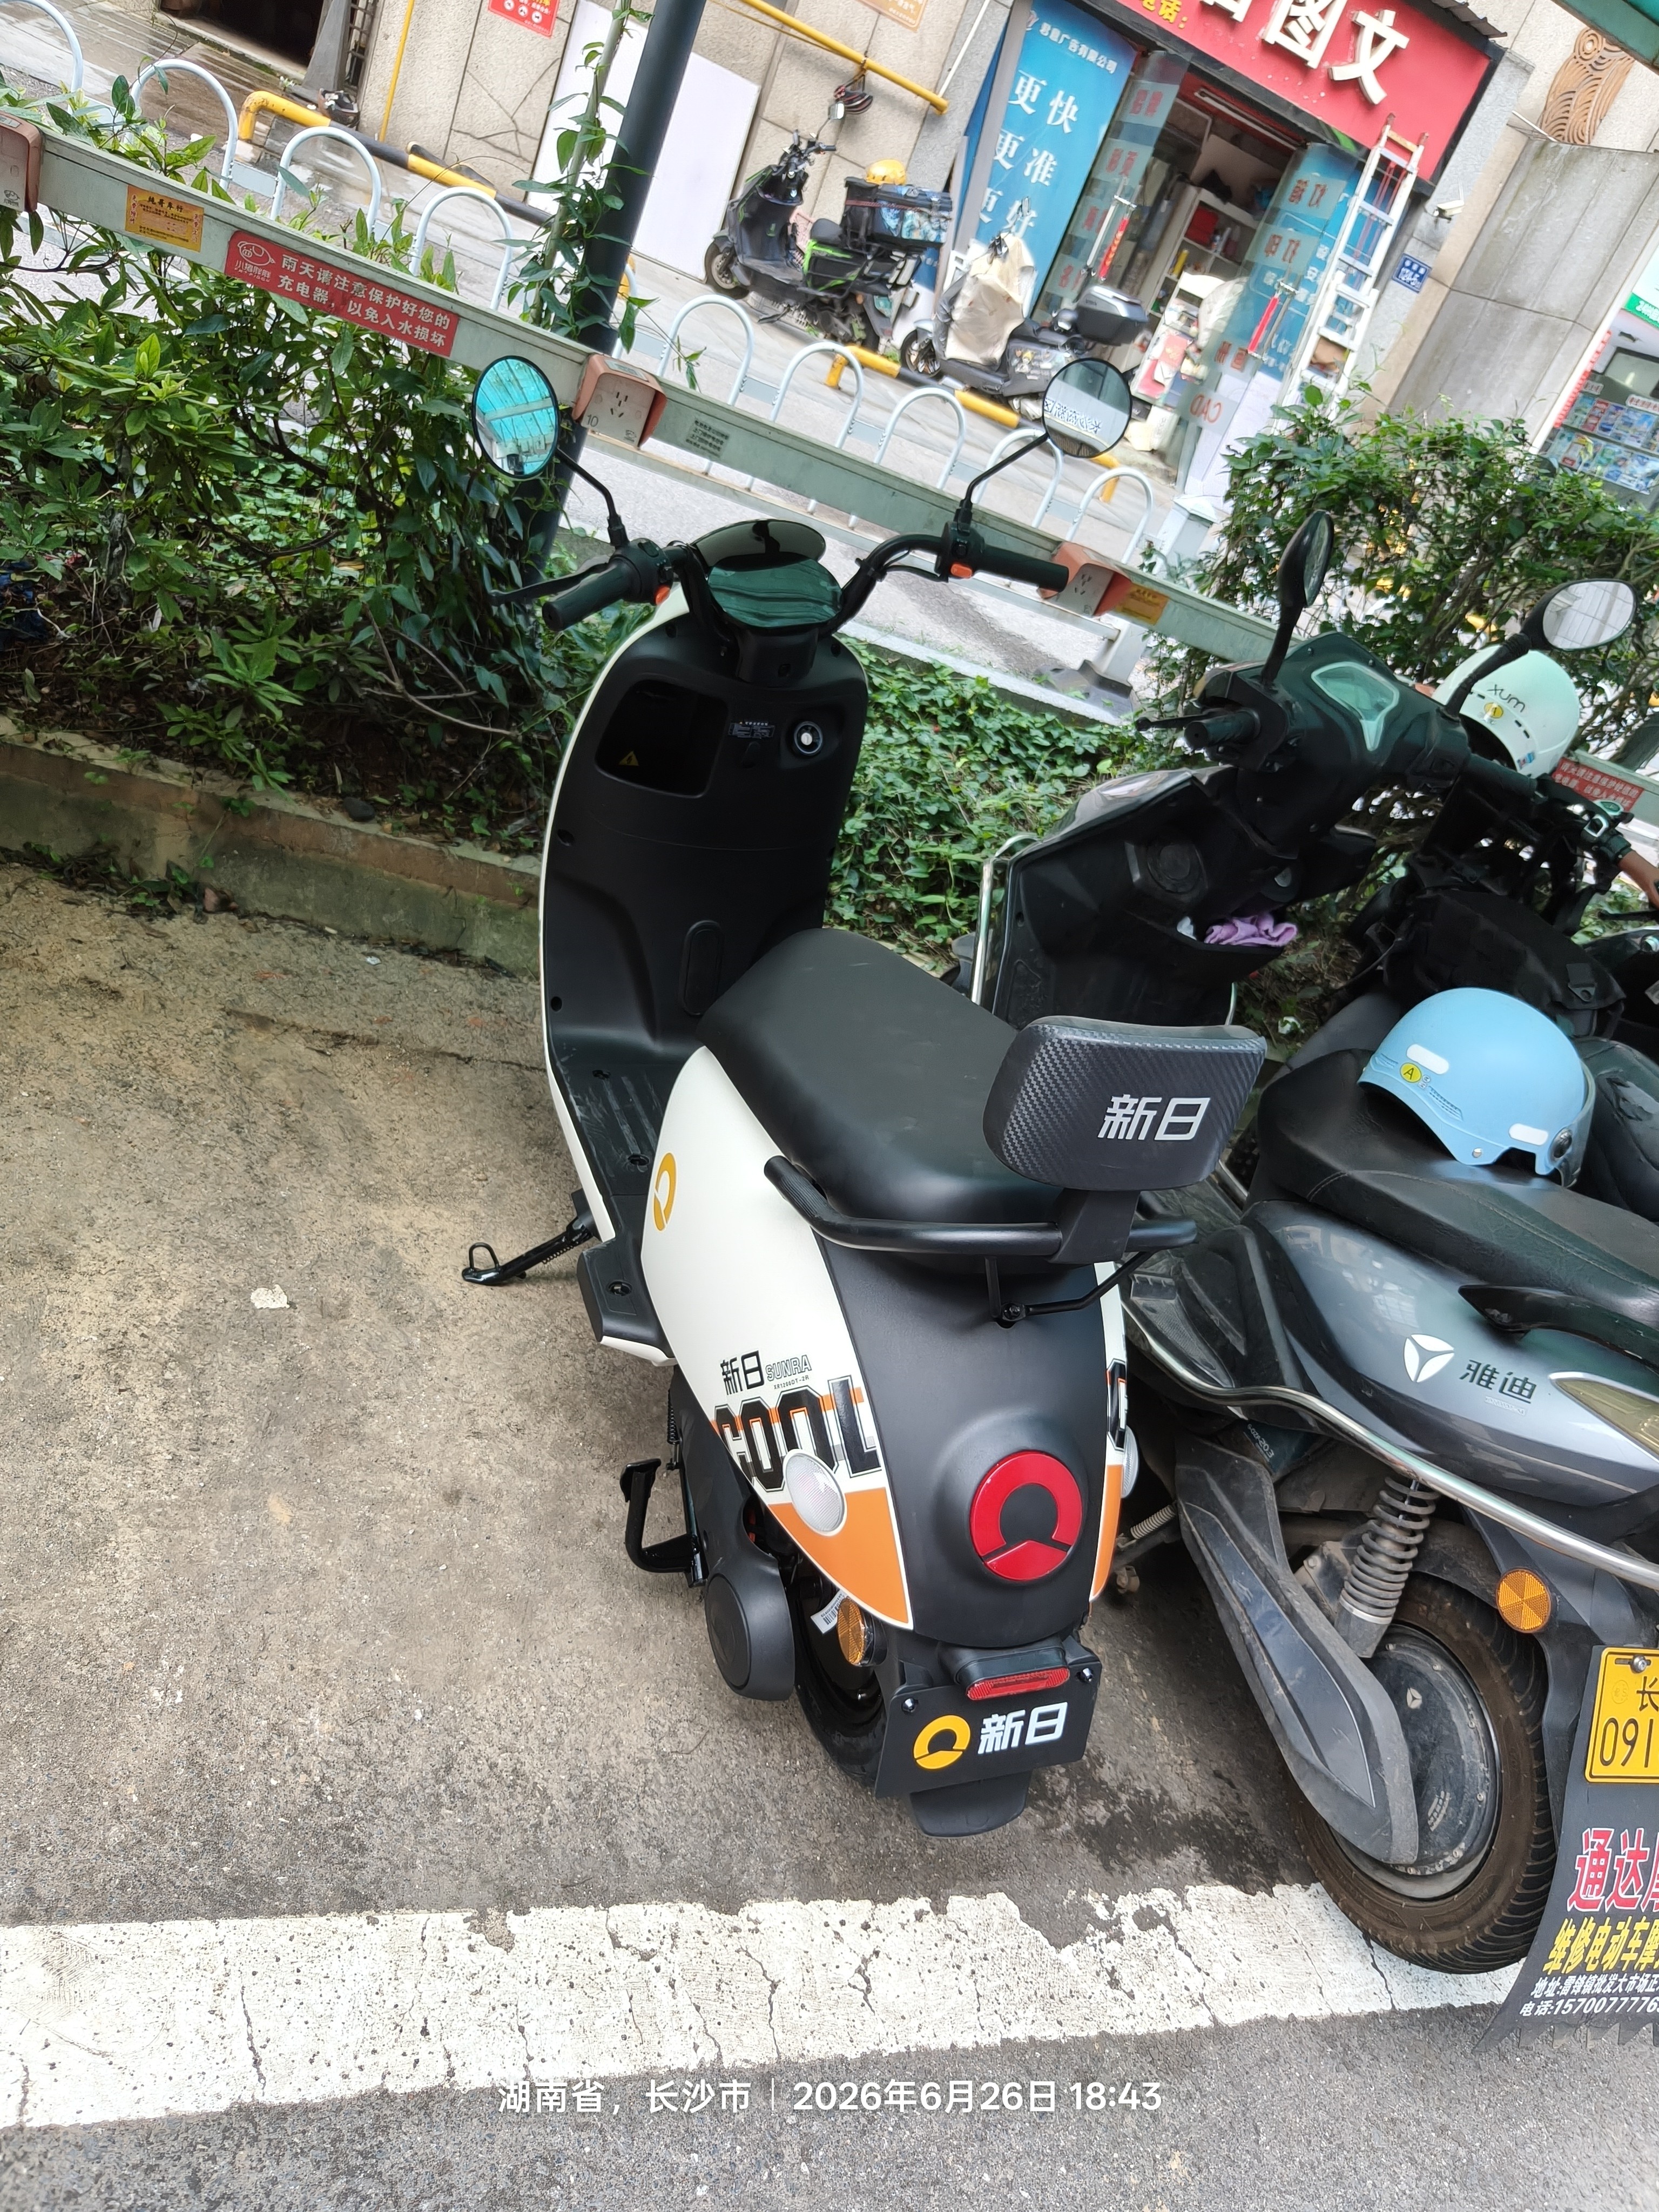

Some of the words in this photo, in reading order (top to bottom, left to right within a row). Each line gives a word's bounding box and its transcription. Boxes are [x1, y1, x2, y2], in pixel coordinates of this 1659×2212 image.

[1200, 0, 1411, 105] 图文
[1008, 70, 1079, 133] 更快
[994, 129, 1057, 186] 更准
[278, 274, 447, 348] 充电器，以免入水损坏
[282, 254, 450, 330] 雨天请注意保护好您的
[586, 414, 599, 427] 10
[1403, 1067, 1414, 1080] A
[1097, 1094, 1211, 1141] 新日
[720, 1350, 765, 1395] 新日
[765, 1354, 813, 1381] SUNRA
[1459, 1359, 1537, 1404] 雅迪
[977, 1702, 1068, 1755] 新日
[1542, 1916, 1659, 1975] 维修电动车摩
[1519, 1997, 1659, 2017] 电话:1570077776
[1530, 1972, 1659, 1999] 地址:雷锋镇批发大市场正
